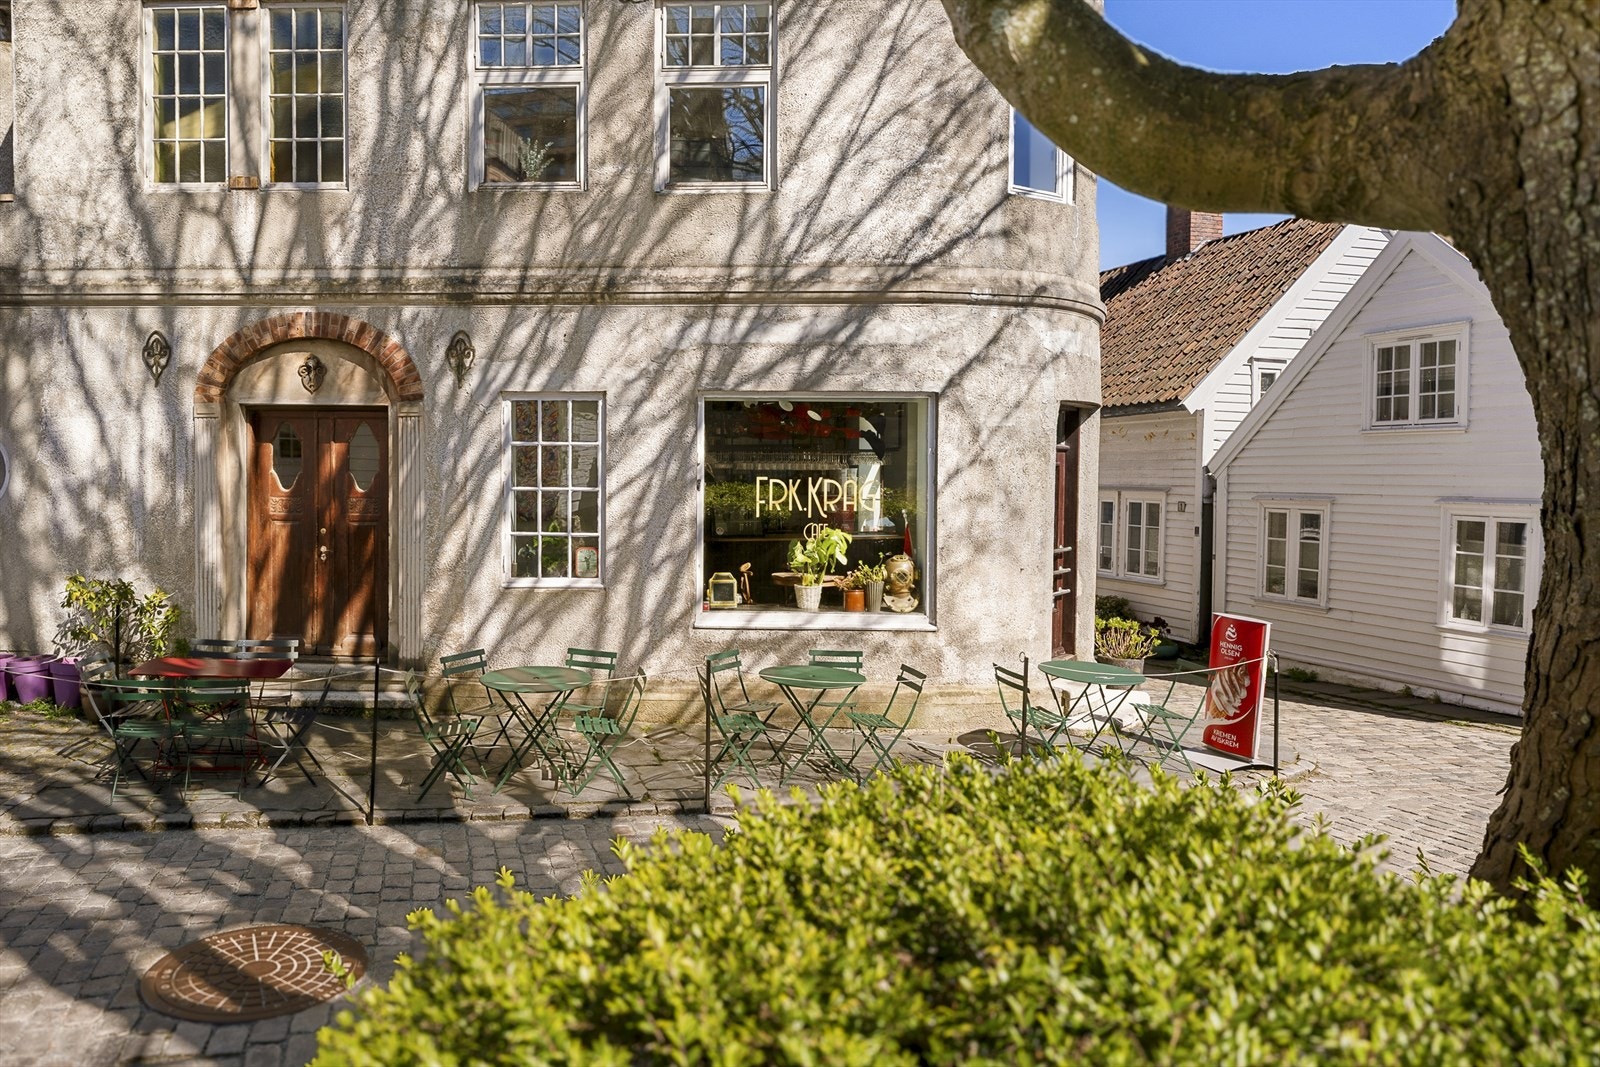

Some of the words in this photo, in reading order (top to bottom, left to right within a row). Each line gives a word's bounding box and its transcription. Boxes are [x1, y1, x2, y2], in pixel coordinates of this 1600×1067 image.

[1219, 640, 1243, 652] HENNIG
[1220, 647, 1241, 657] OLSEN
[1213, 729, 1237, 741] KREMEN
